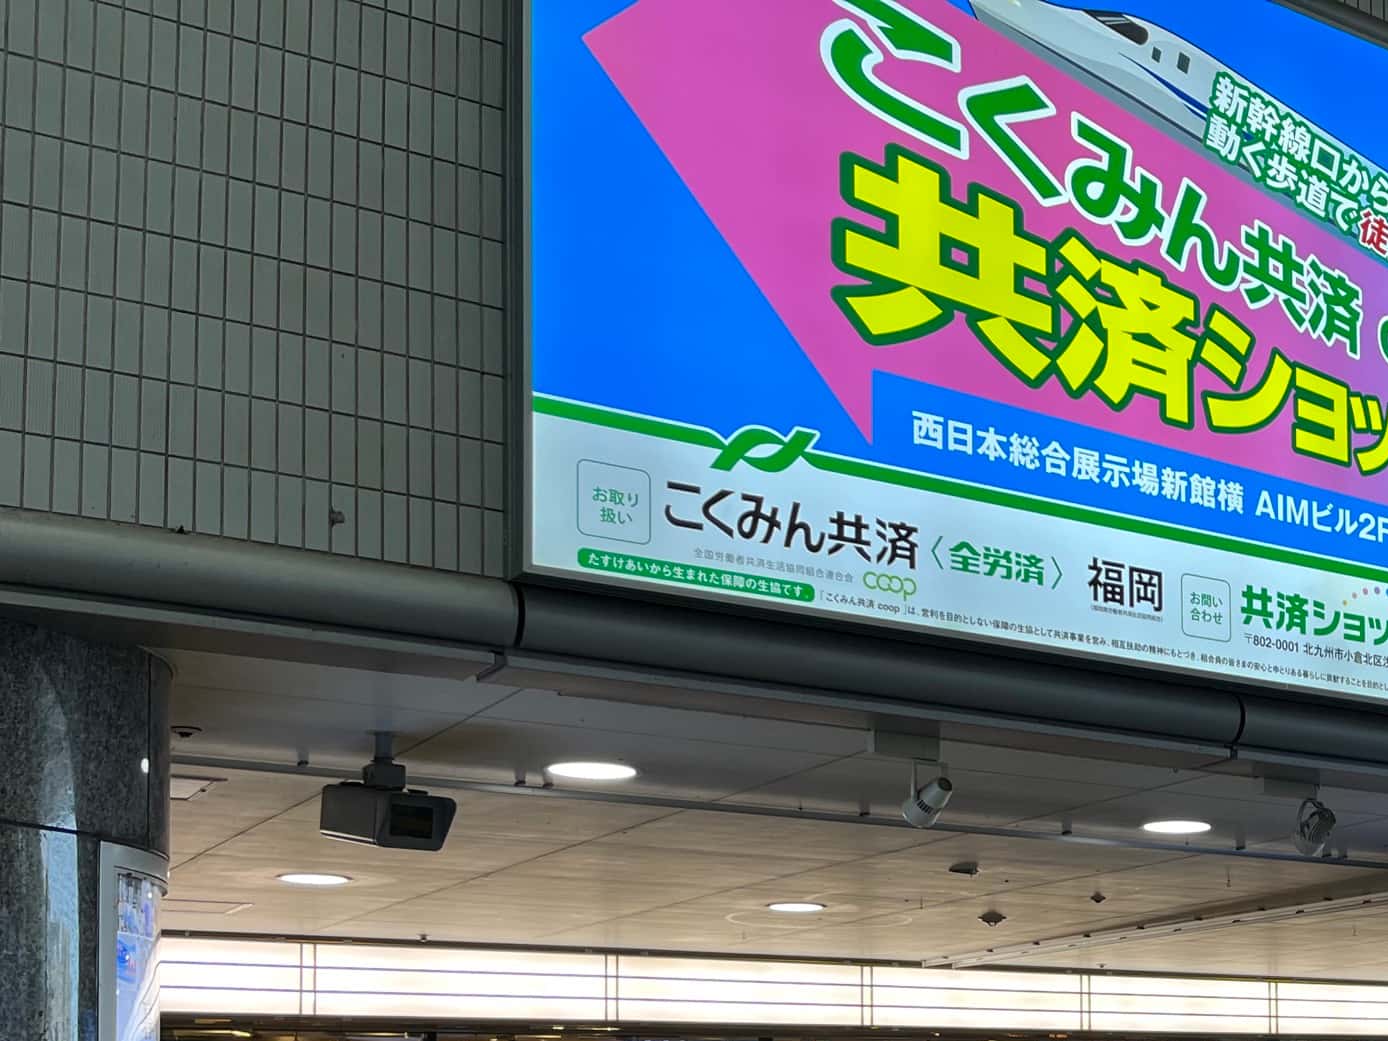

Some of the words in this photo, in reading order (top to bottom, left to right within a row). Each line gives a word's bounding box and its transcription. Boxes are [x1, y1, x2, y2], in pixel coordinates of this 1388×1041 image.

[820, 0, 1362, 360] こくみん共済
[912, 411, 1245, 515] 西日本総合展示場新館横
[592, 486, 639, 507] お取り
[599, 508, 633, 526] 扱い
[664, 480, 918, 569] こくみん共済
[1087, 556, 1164, 613] 福岡
[863, 570, 917, 601] coop
[1189, 591, 1224, 609] お問い
[1189, 608, 1224, 626] 合わせ
